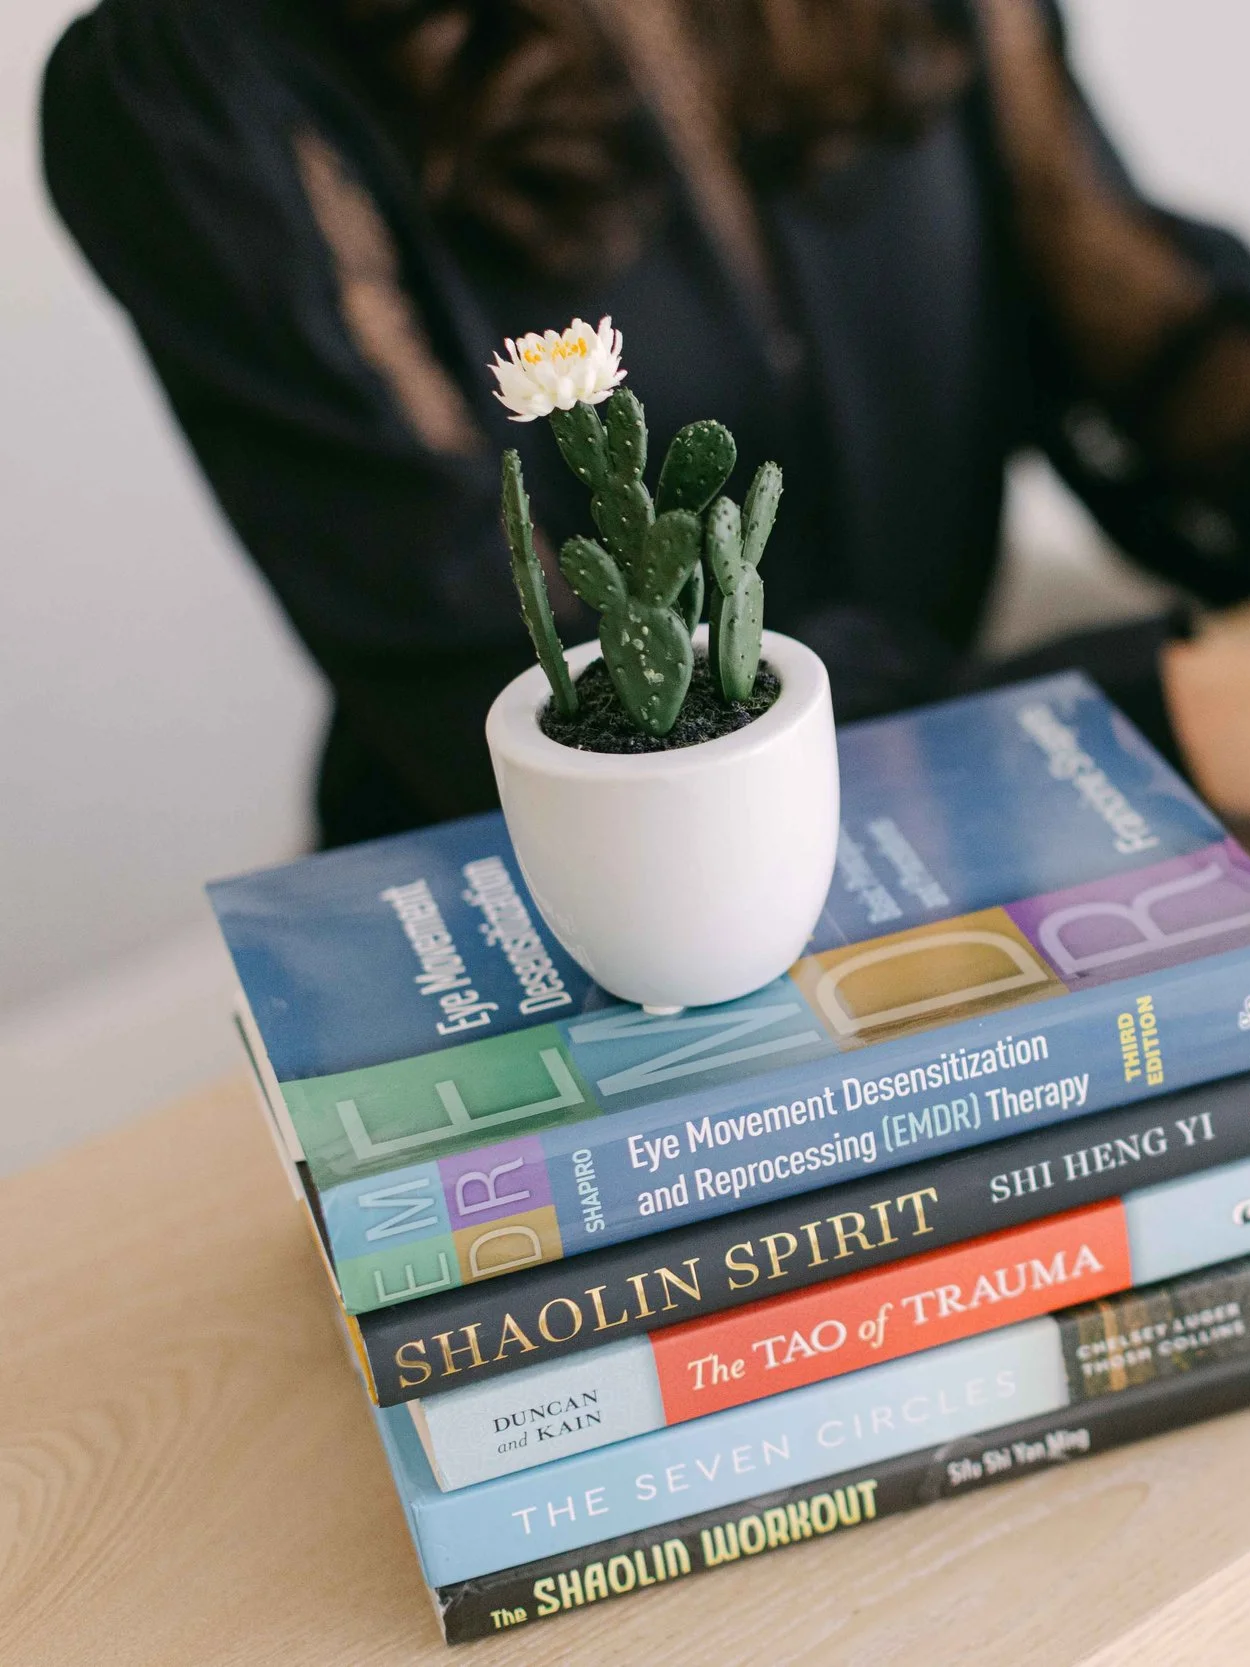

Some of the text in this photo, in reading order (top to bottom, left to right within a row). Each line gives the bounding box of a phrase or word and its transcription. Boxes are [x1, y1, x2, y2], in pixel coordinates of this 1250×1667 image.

[379, 878, 499, 1036] Eye Movement
[462, 855, 572, 1015] Desensitization
[628, 1035, 1049, 1173] Eye Movement Desensitization
[1117, 1012, 1142, 1083] THIRD
[1136, 995, 1164, 1087] EDITION
[572, 1148, 605, 1234] SHAPIRO
[637, 1073, 1090, 1216] and Reprocessing (EMDR) Therapy
[989, 1112, 1216, 1203] SHI HENG YI
[395, 1187, 938, 1389] SHAOLIN SPIRIT
[687, 1243, 1104, 1391] The TAO of TRAUMA
[493, 1389, 599, 1434] DUNCAN
[497, 1410, 602, 1455] and KAIN
[512, 1370, 1016, 1534] THE SEVEN CIRCLES
[490, 1478, 879, 1630] The SHAOLIN WORKOUT
